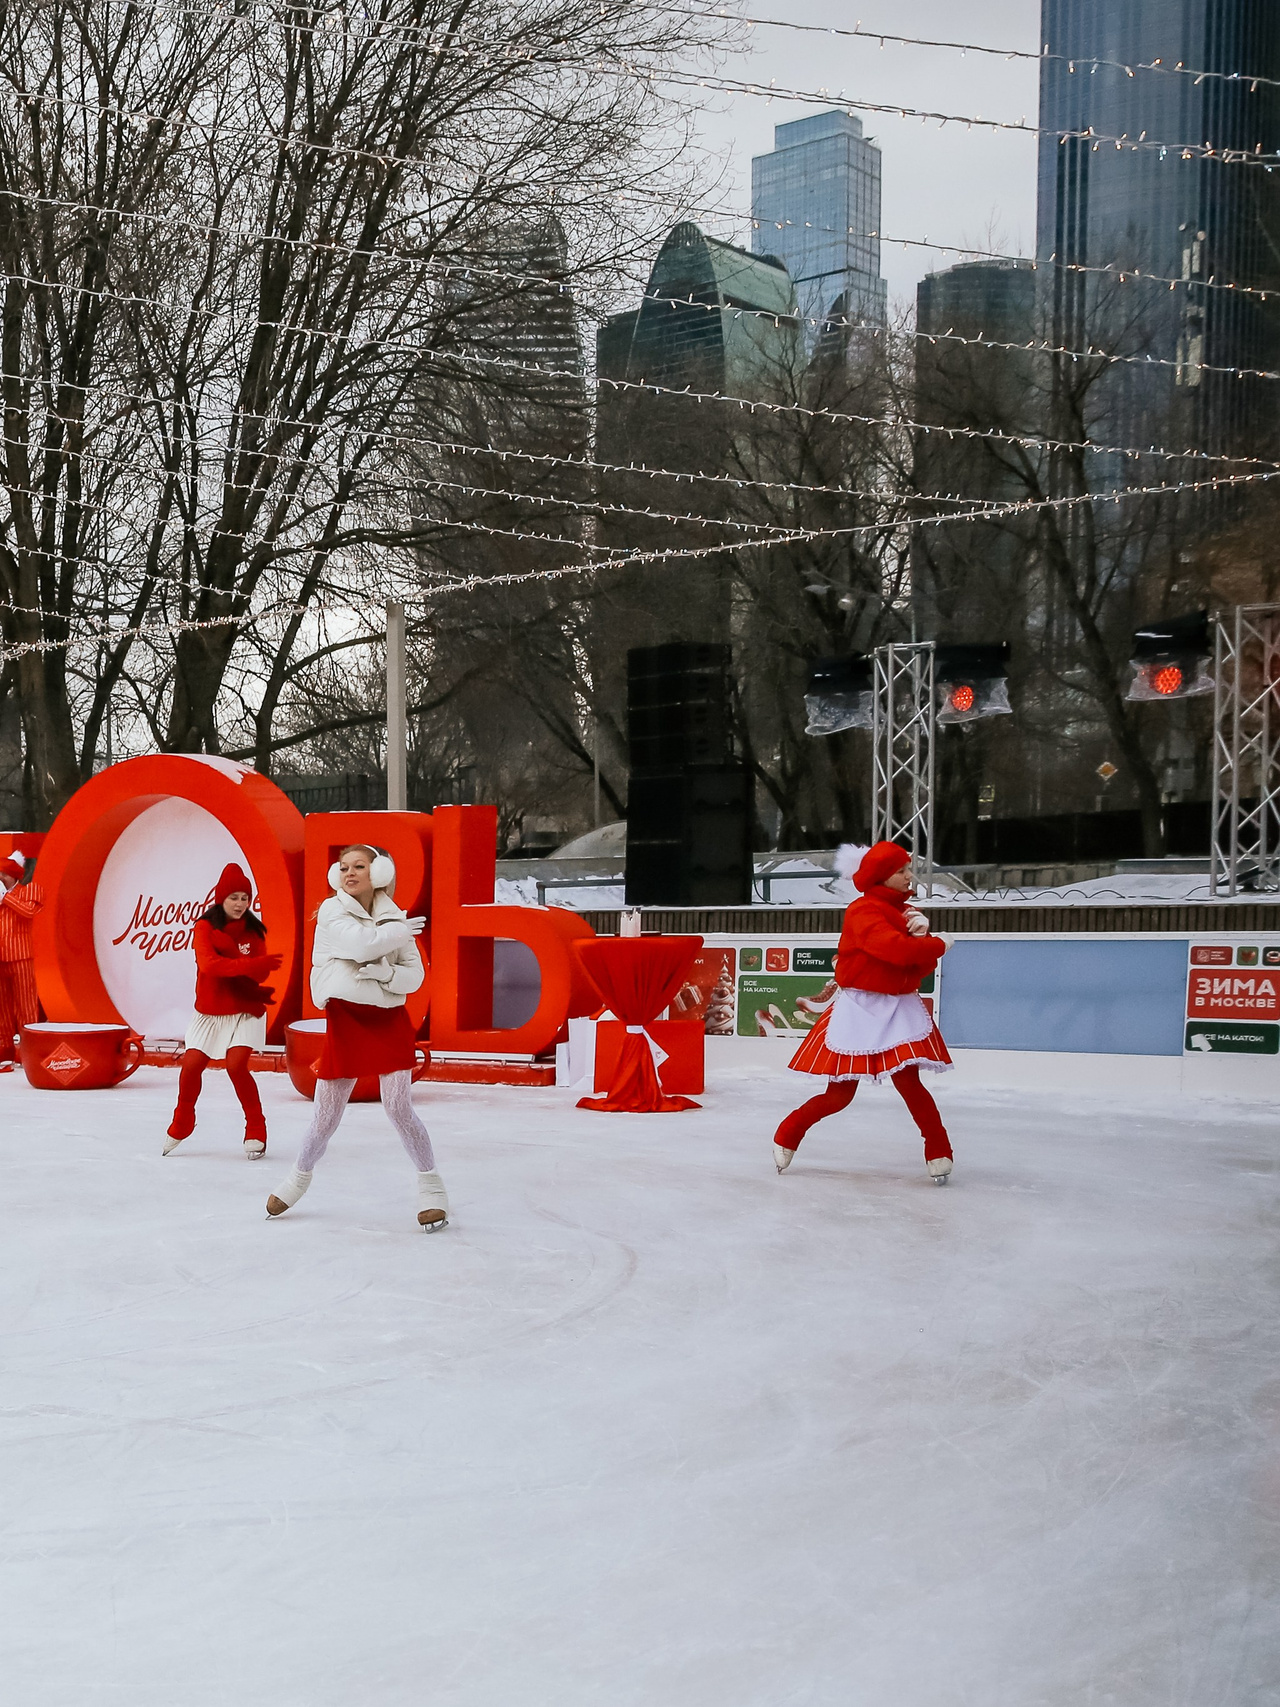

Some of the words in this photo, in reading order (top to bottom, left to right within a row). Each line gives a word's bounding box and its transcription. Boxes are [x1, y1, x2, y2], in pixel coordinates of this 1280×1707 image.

[1195, 977, 1276, 996] ЗИМА
[1194, 997, 1205, 1006] В
[1210, 998, 1276, 1008] МОСКВЕ
